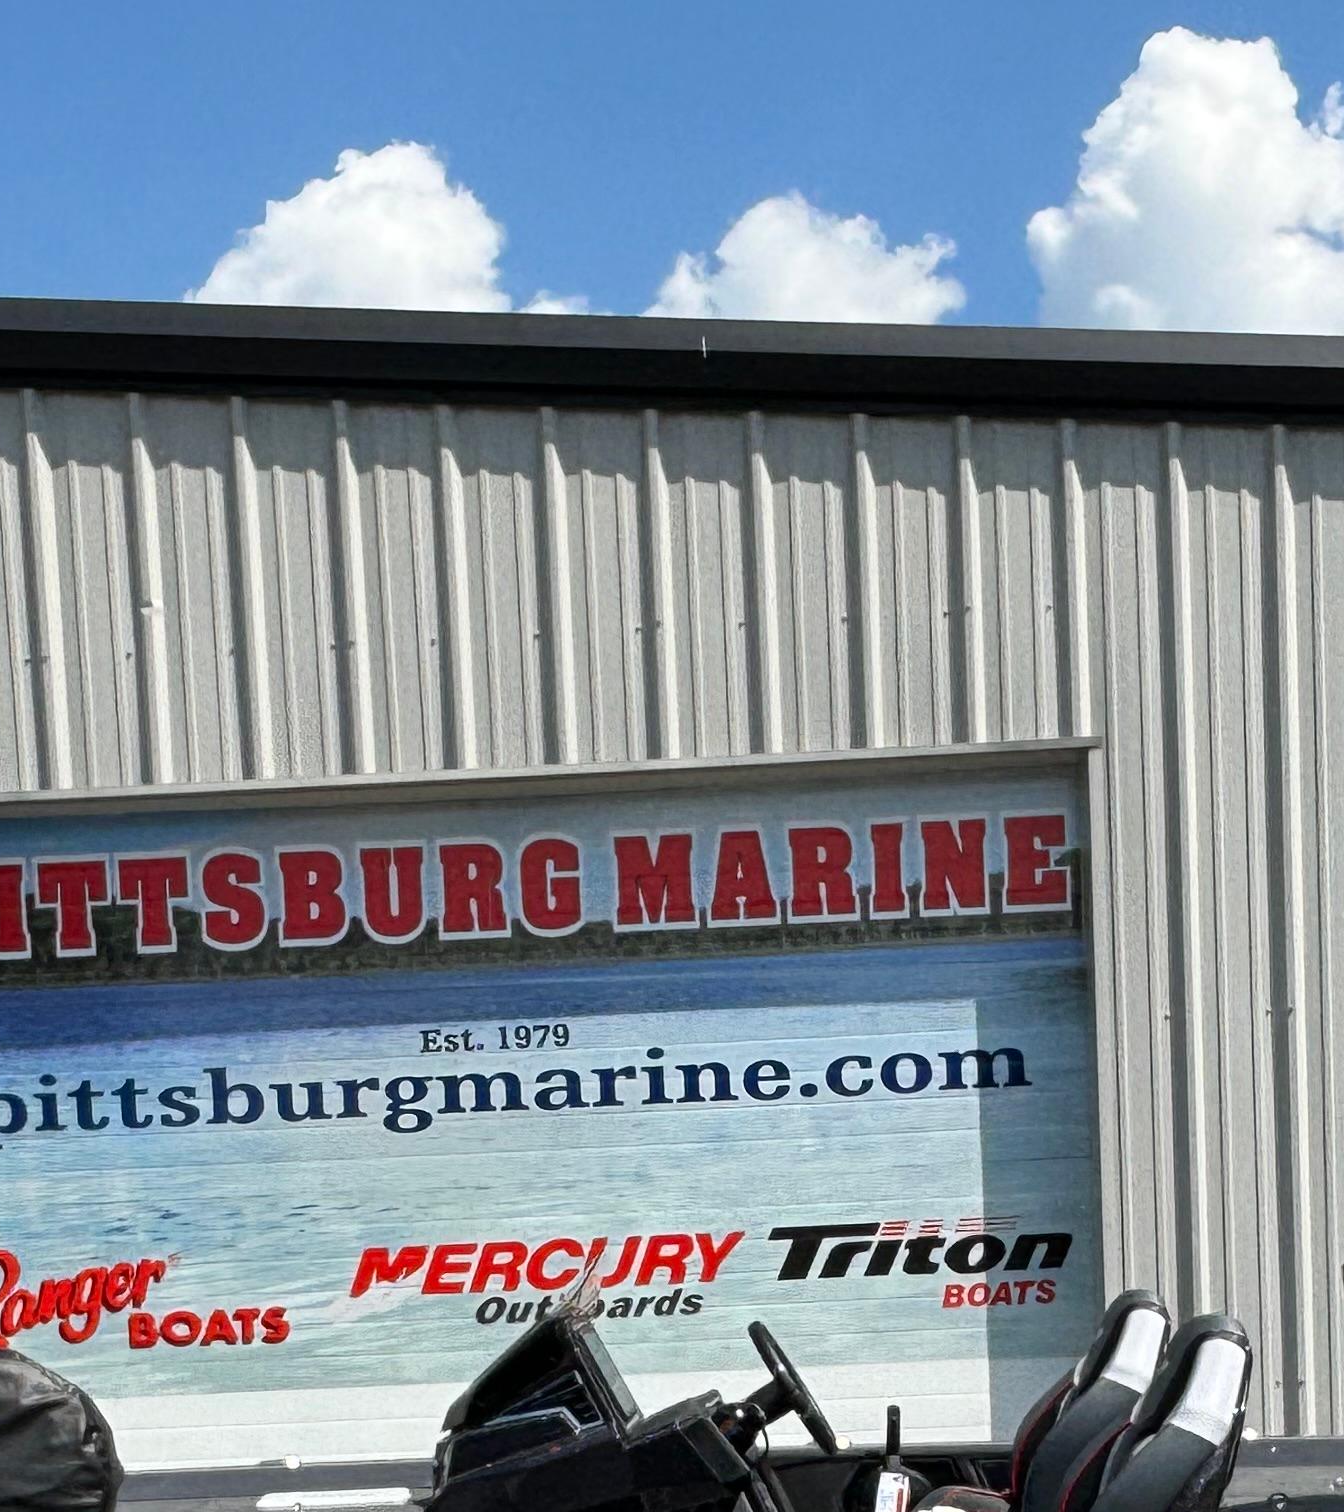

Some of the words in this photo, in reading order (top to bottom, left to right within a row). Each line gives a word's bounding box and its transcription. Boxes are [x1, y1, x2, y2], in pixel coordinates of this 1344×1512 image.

[613, 810, 1073, 933] MARINE
[419, 1028, 485, 1053] Est.
[498, 1023, 570, 1050] 1979
[349, 1231, 747, 1298] MERCURY
[768, 1220, 1074, 1281] Triton
[476, 1288, 704, 1325] Outards
[942, 1279, 1057, 1308] BOATS
[129, 1306, 291, 1349] BOATS
